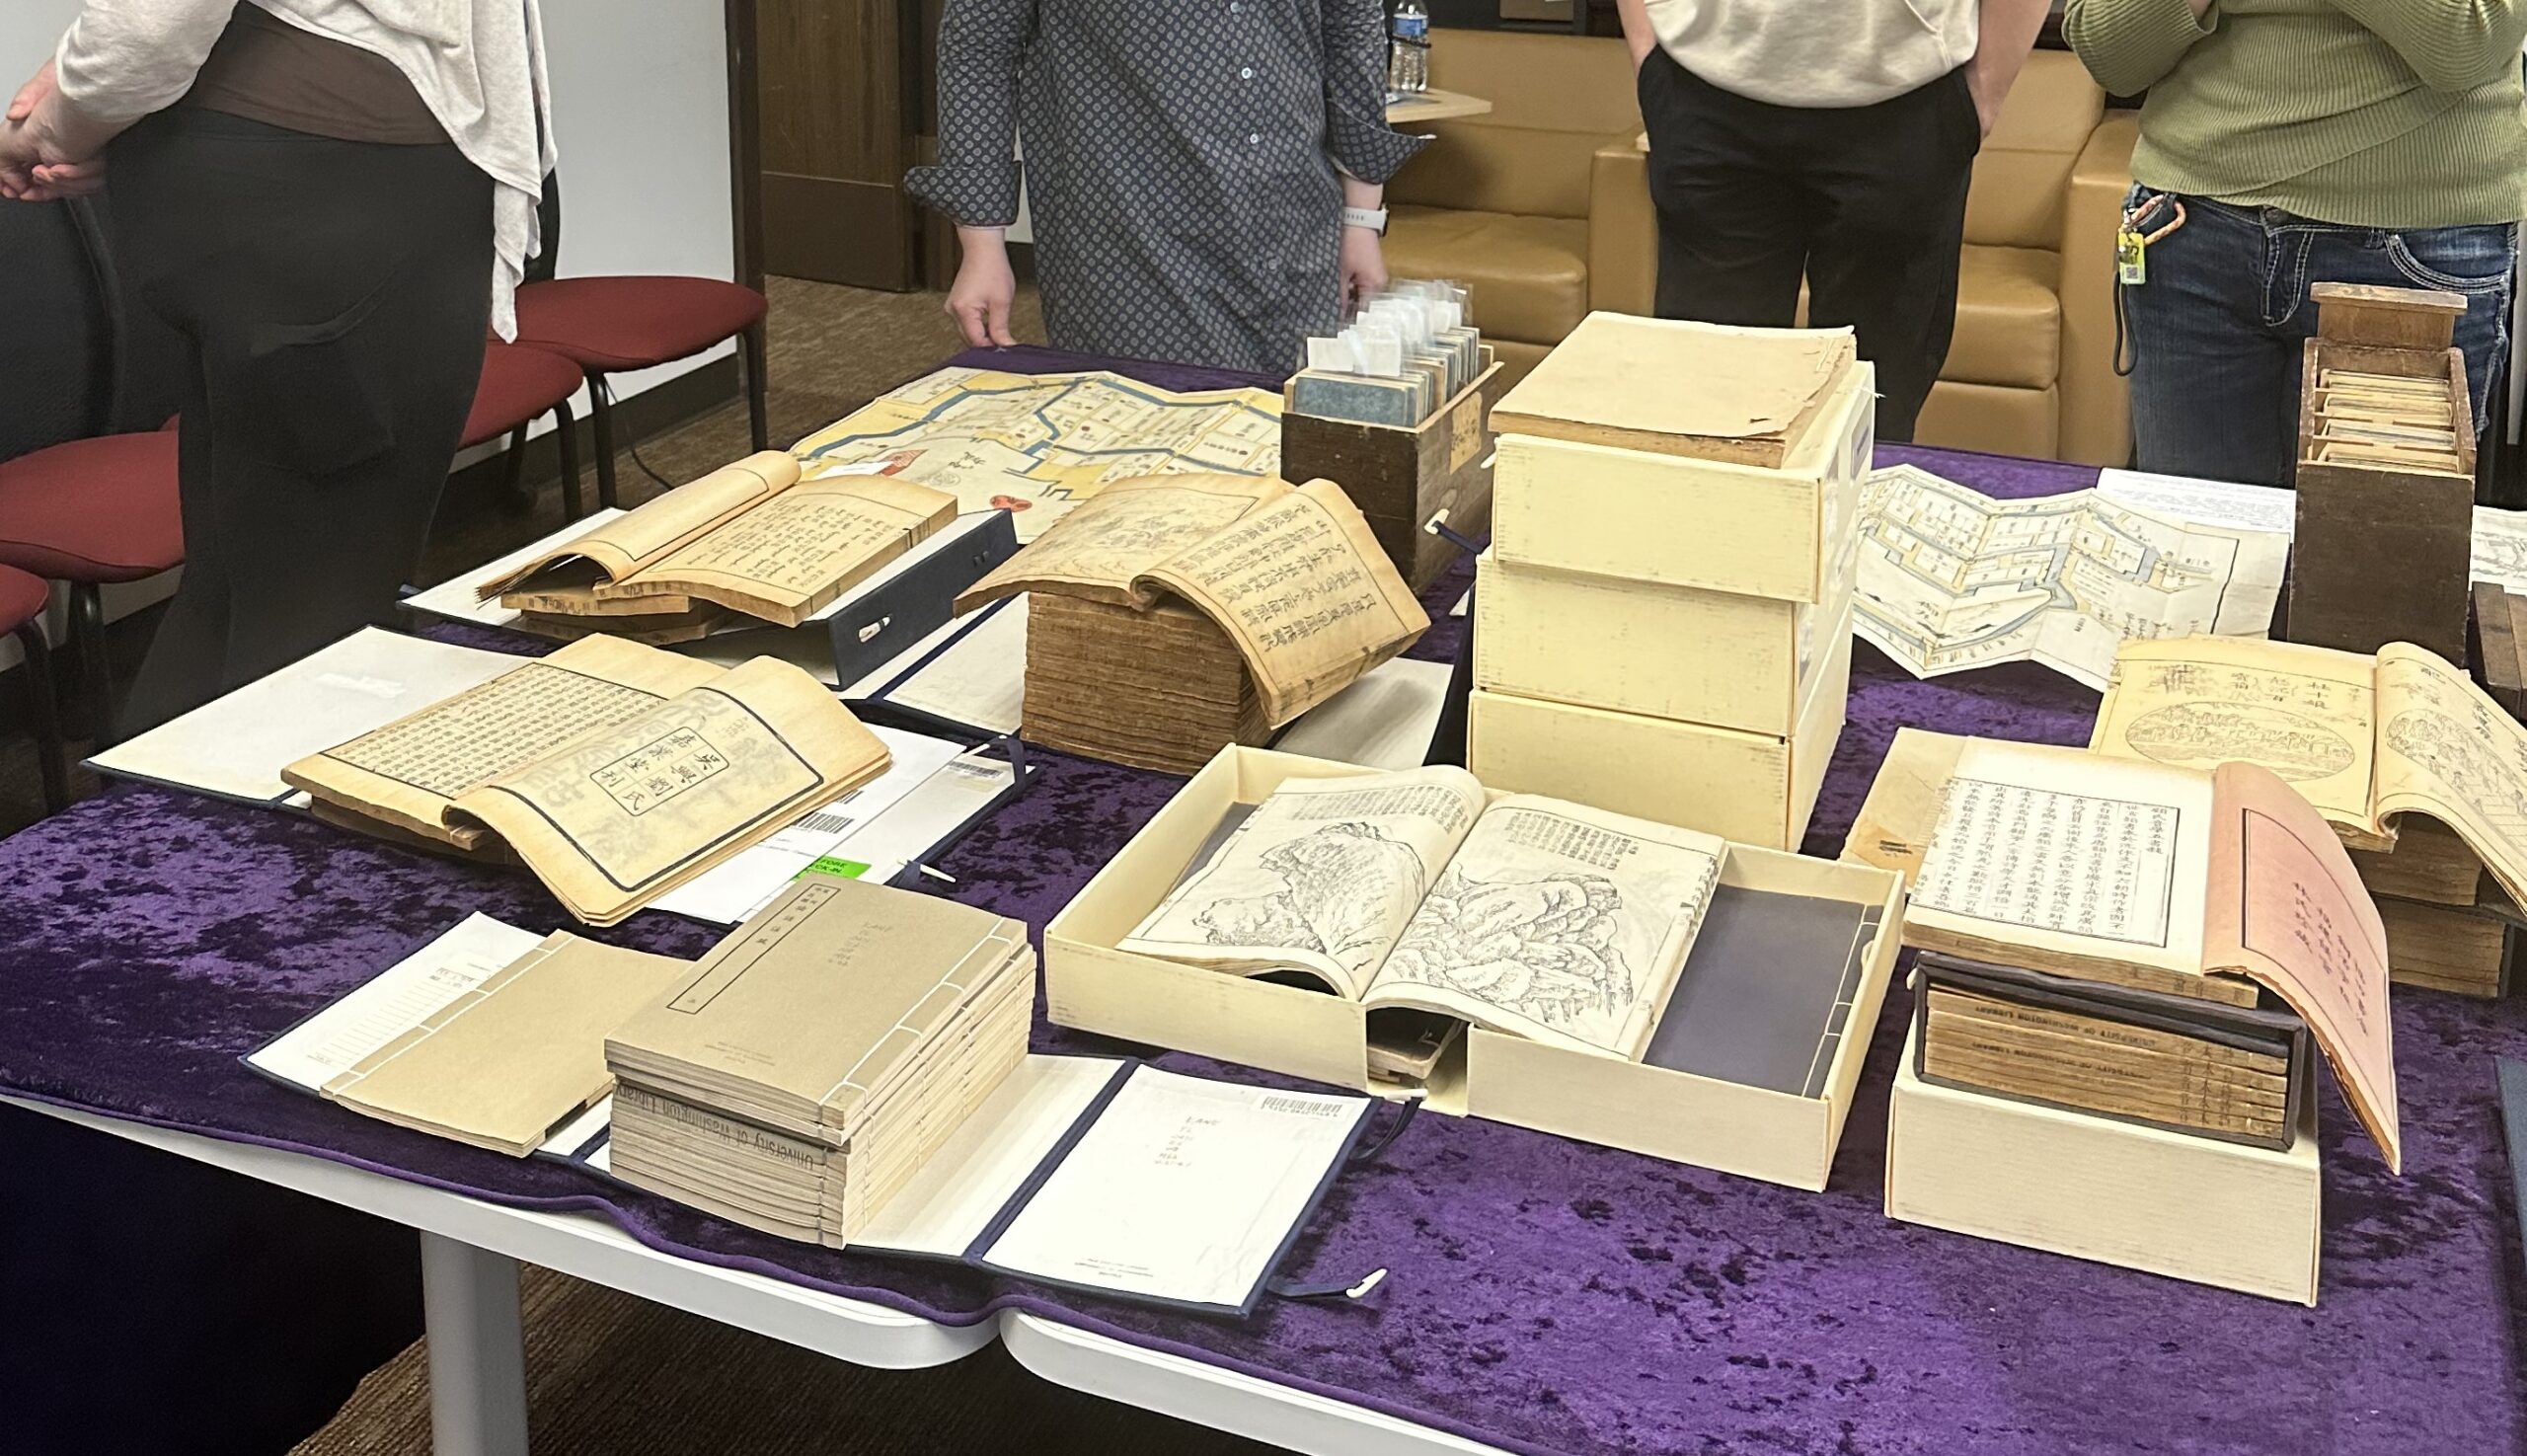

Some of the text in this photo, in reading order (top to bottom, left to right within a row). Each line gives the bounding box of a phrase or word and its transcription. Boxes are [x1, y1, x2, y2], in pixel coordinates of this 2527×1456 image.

[614, 1086, 814, 1172] University of Washington Library
